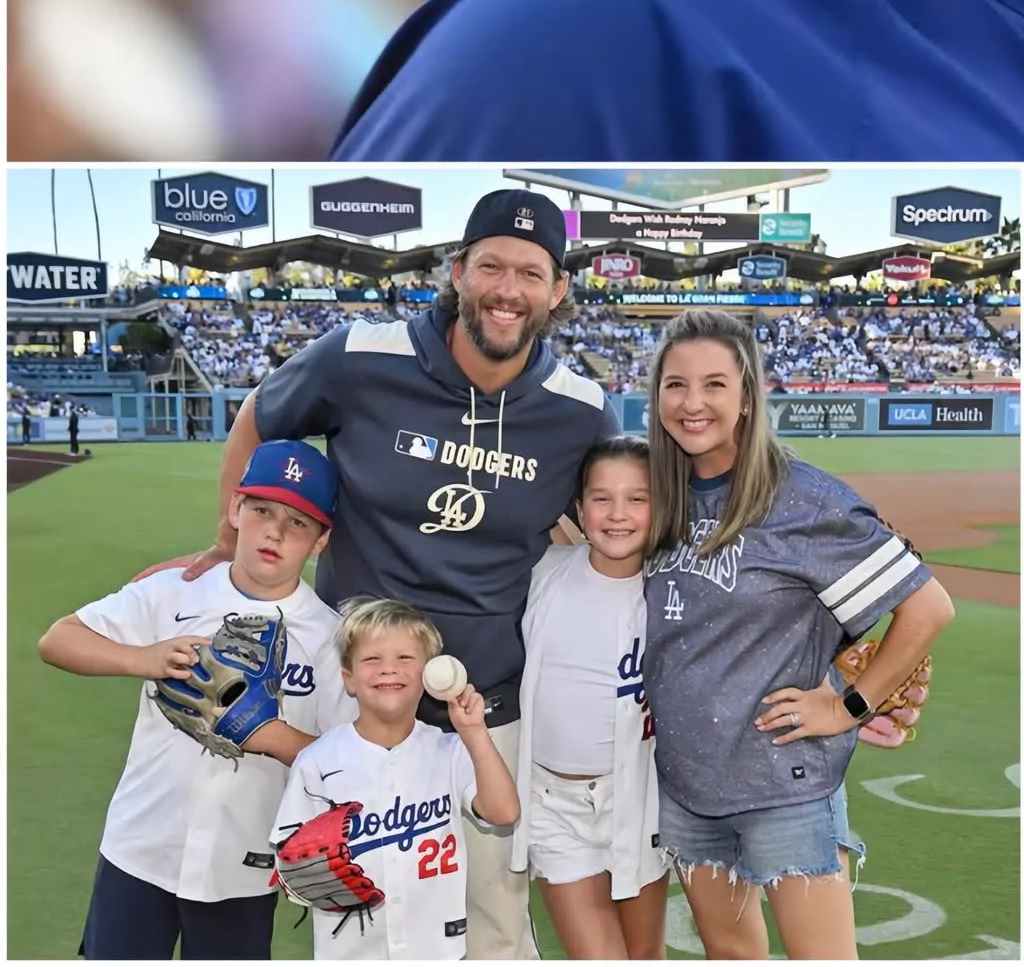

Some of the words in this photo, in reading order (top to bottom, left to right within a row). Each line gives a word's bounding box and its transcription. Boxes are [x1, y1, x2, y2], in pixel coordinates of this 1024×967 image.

[164, 182, 228, 210] blue
[320, 201, 415, 214] GUGGENHEIM
[175, 211, 236, 223] california
[902, 204, 988, 226] Spectrum
[894, 408, 927, 421] UCLA
[936, 407, 983, 422] Health
[284, 457, 303, 483] LA
[440, 440, 538, 482] DODGERS
[664, 580, 685, 620] LA
[417, 833, 459, 880] 22
